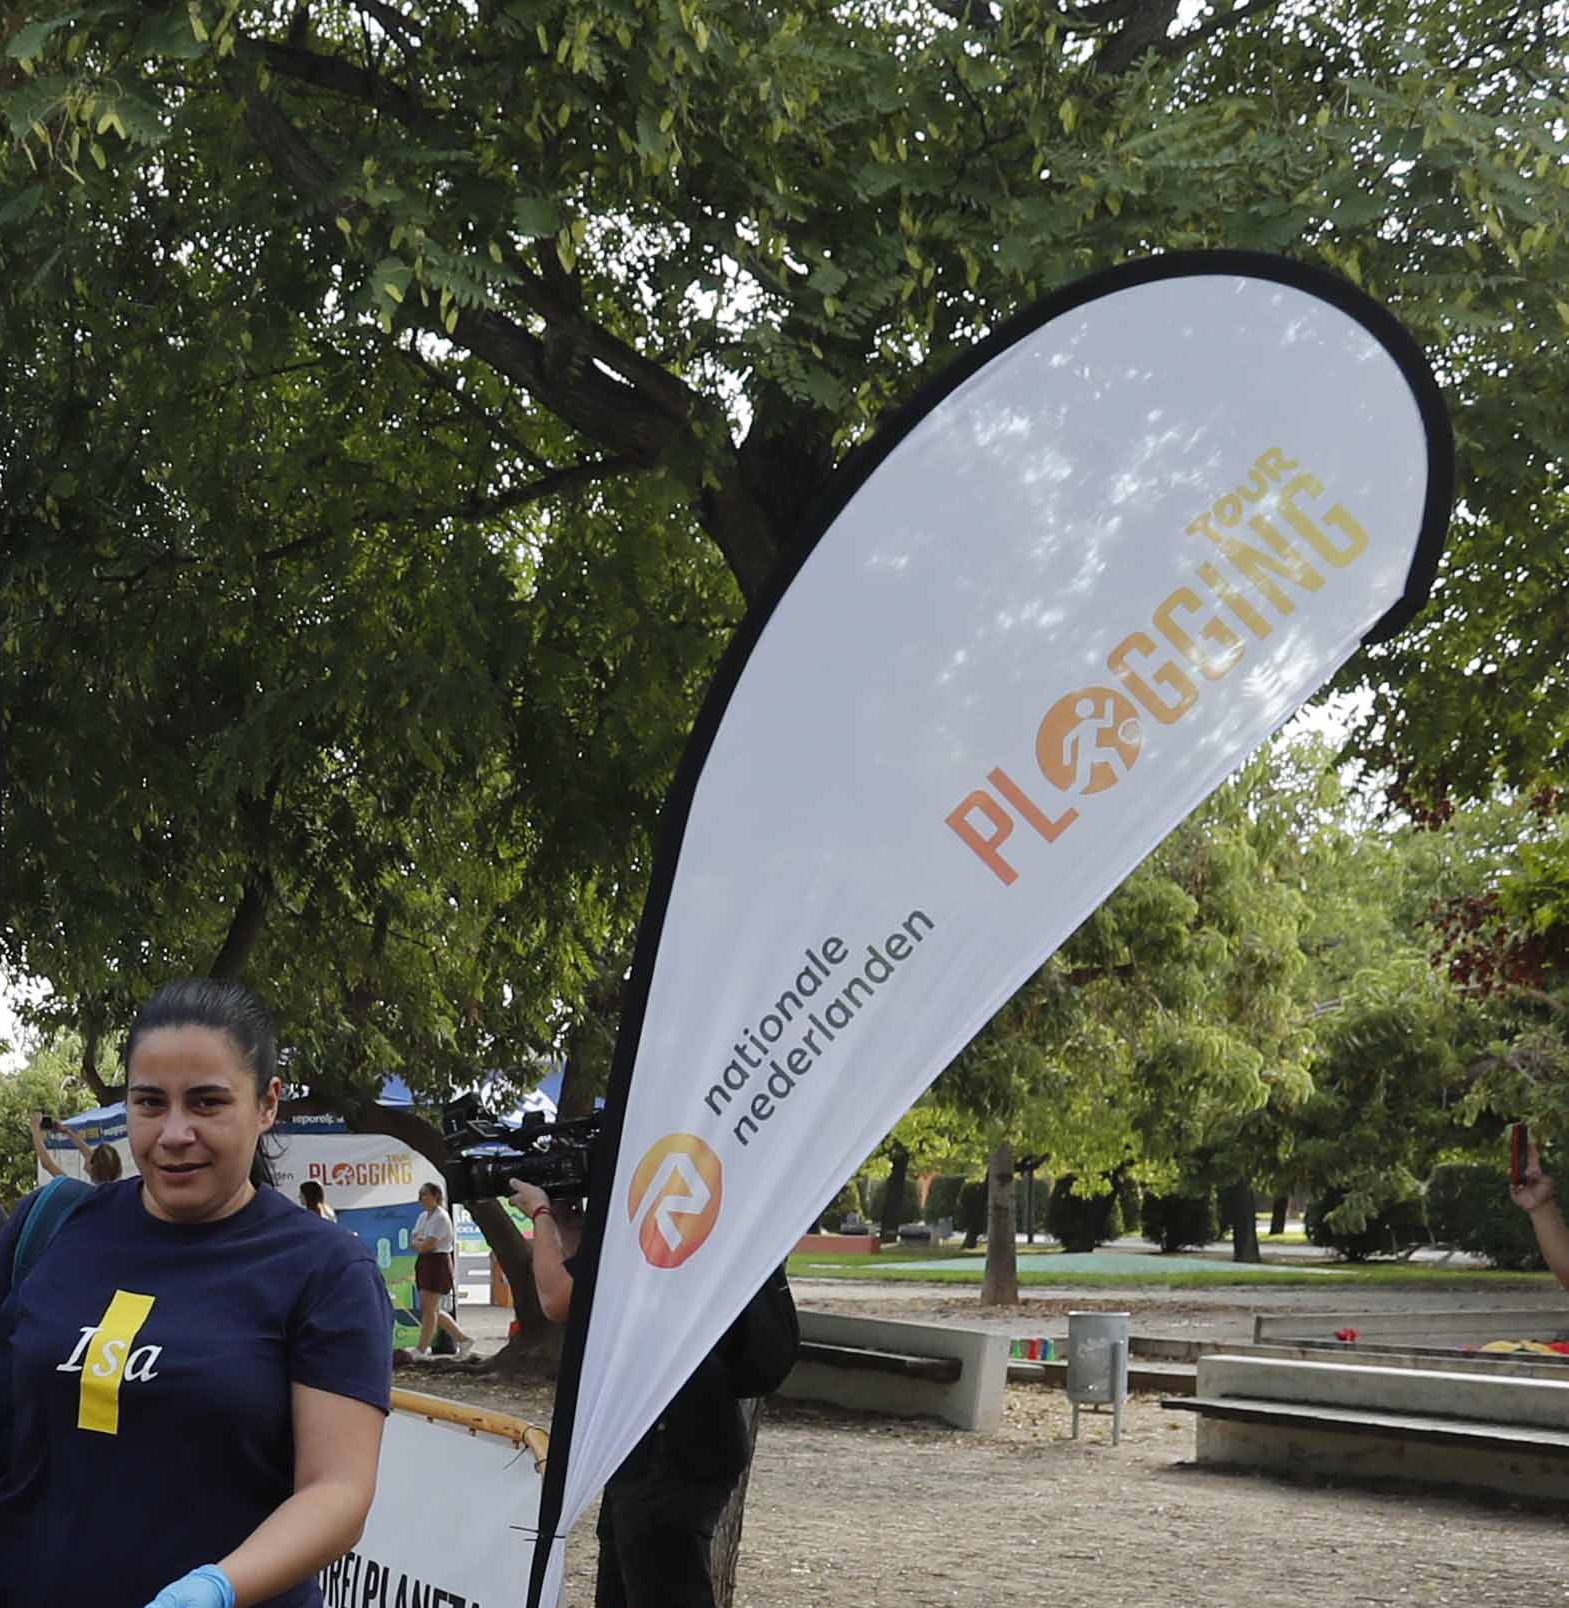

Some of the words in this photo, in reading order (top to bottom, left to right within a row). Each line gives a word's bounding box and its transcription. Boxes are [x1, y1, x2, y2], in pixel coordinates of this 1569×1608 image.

[1185, 446, 1296, 544] TOUR
[944, 473, 1369, 887] PLOGGING
[702, 933, 850, 1117] nationale
[732, 909, 935, 1147] nederlanden
[309, 1162, 413, 1186] PLOGGING
[56, 1326, 163, 1382] Isa
